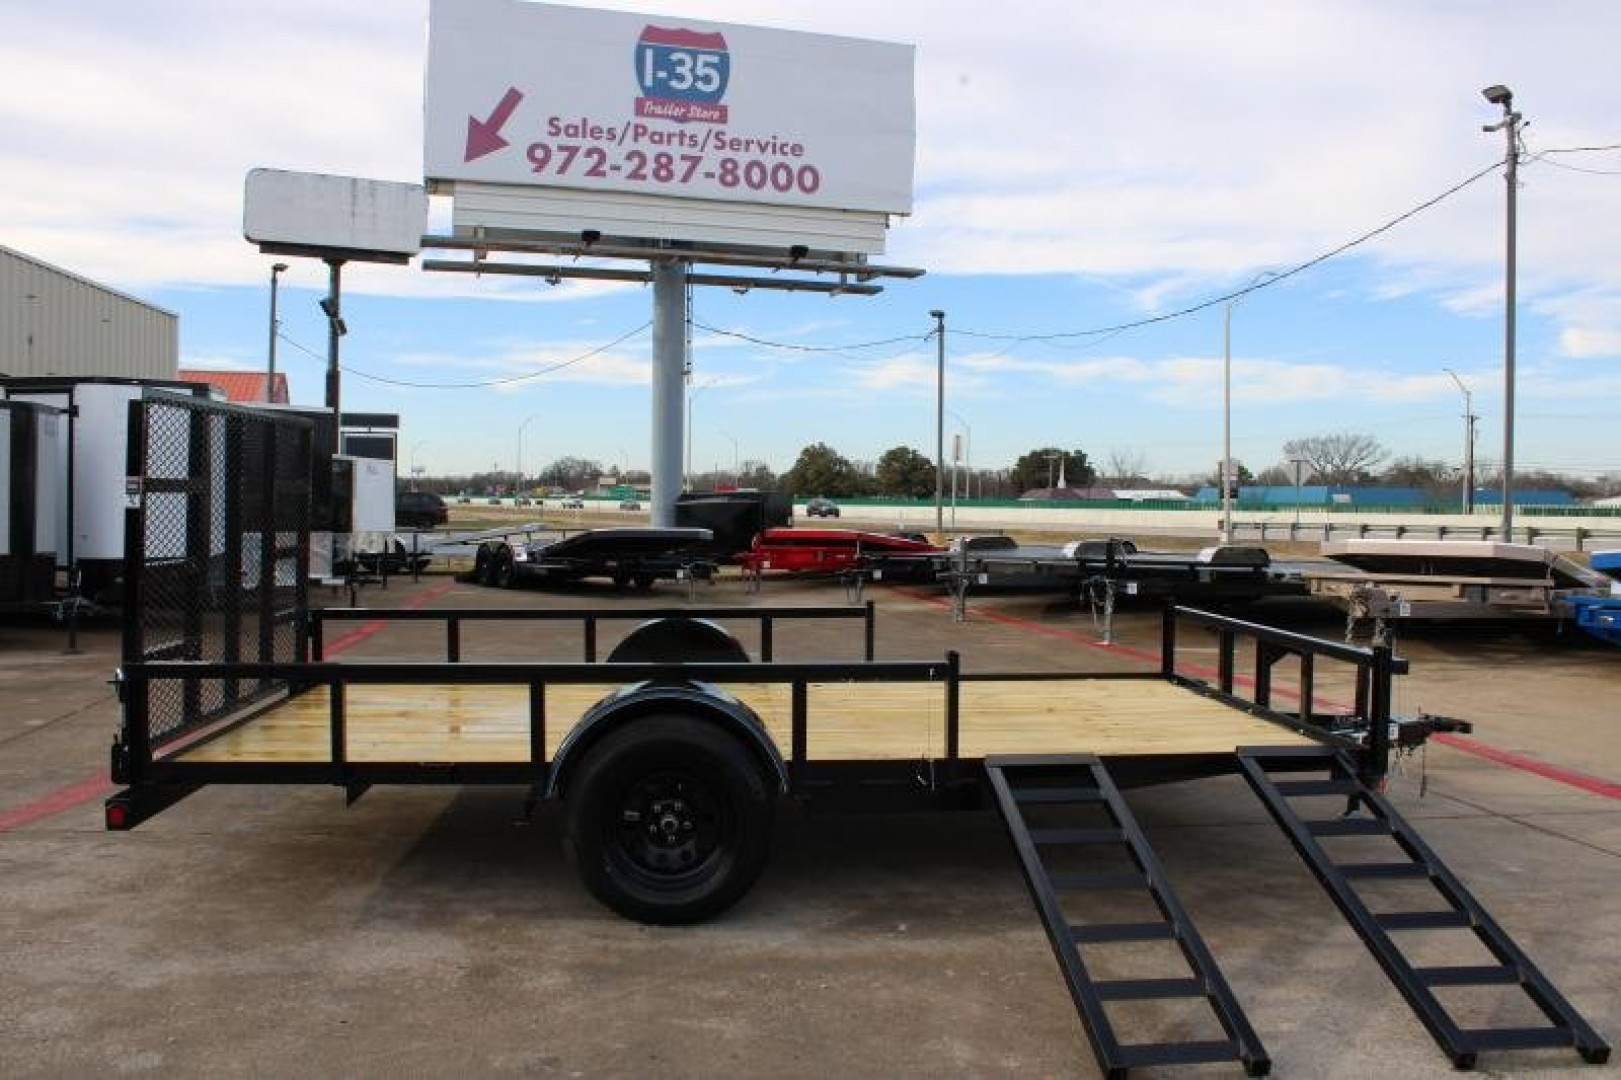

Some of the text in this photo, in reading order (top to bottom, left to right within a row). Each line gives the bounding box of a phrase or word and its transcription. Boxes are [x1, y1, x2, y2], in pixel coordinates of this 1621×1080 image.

[644, 48, 720, 92] I-35
[643, 101, 686, 116] Trailer
[548, 116, 804, 157] Sales/Parts/Service
[526, 142, 820, 194] 972-287-8000
